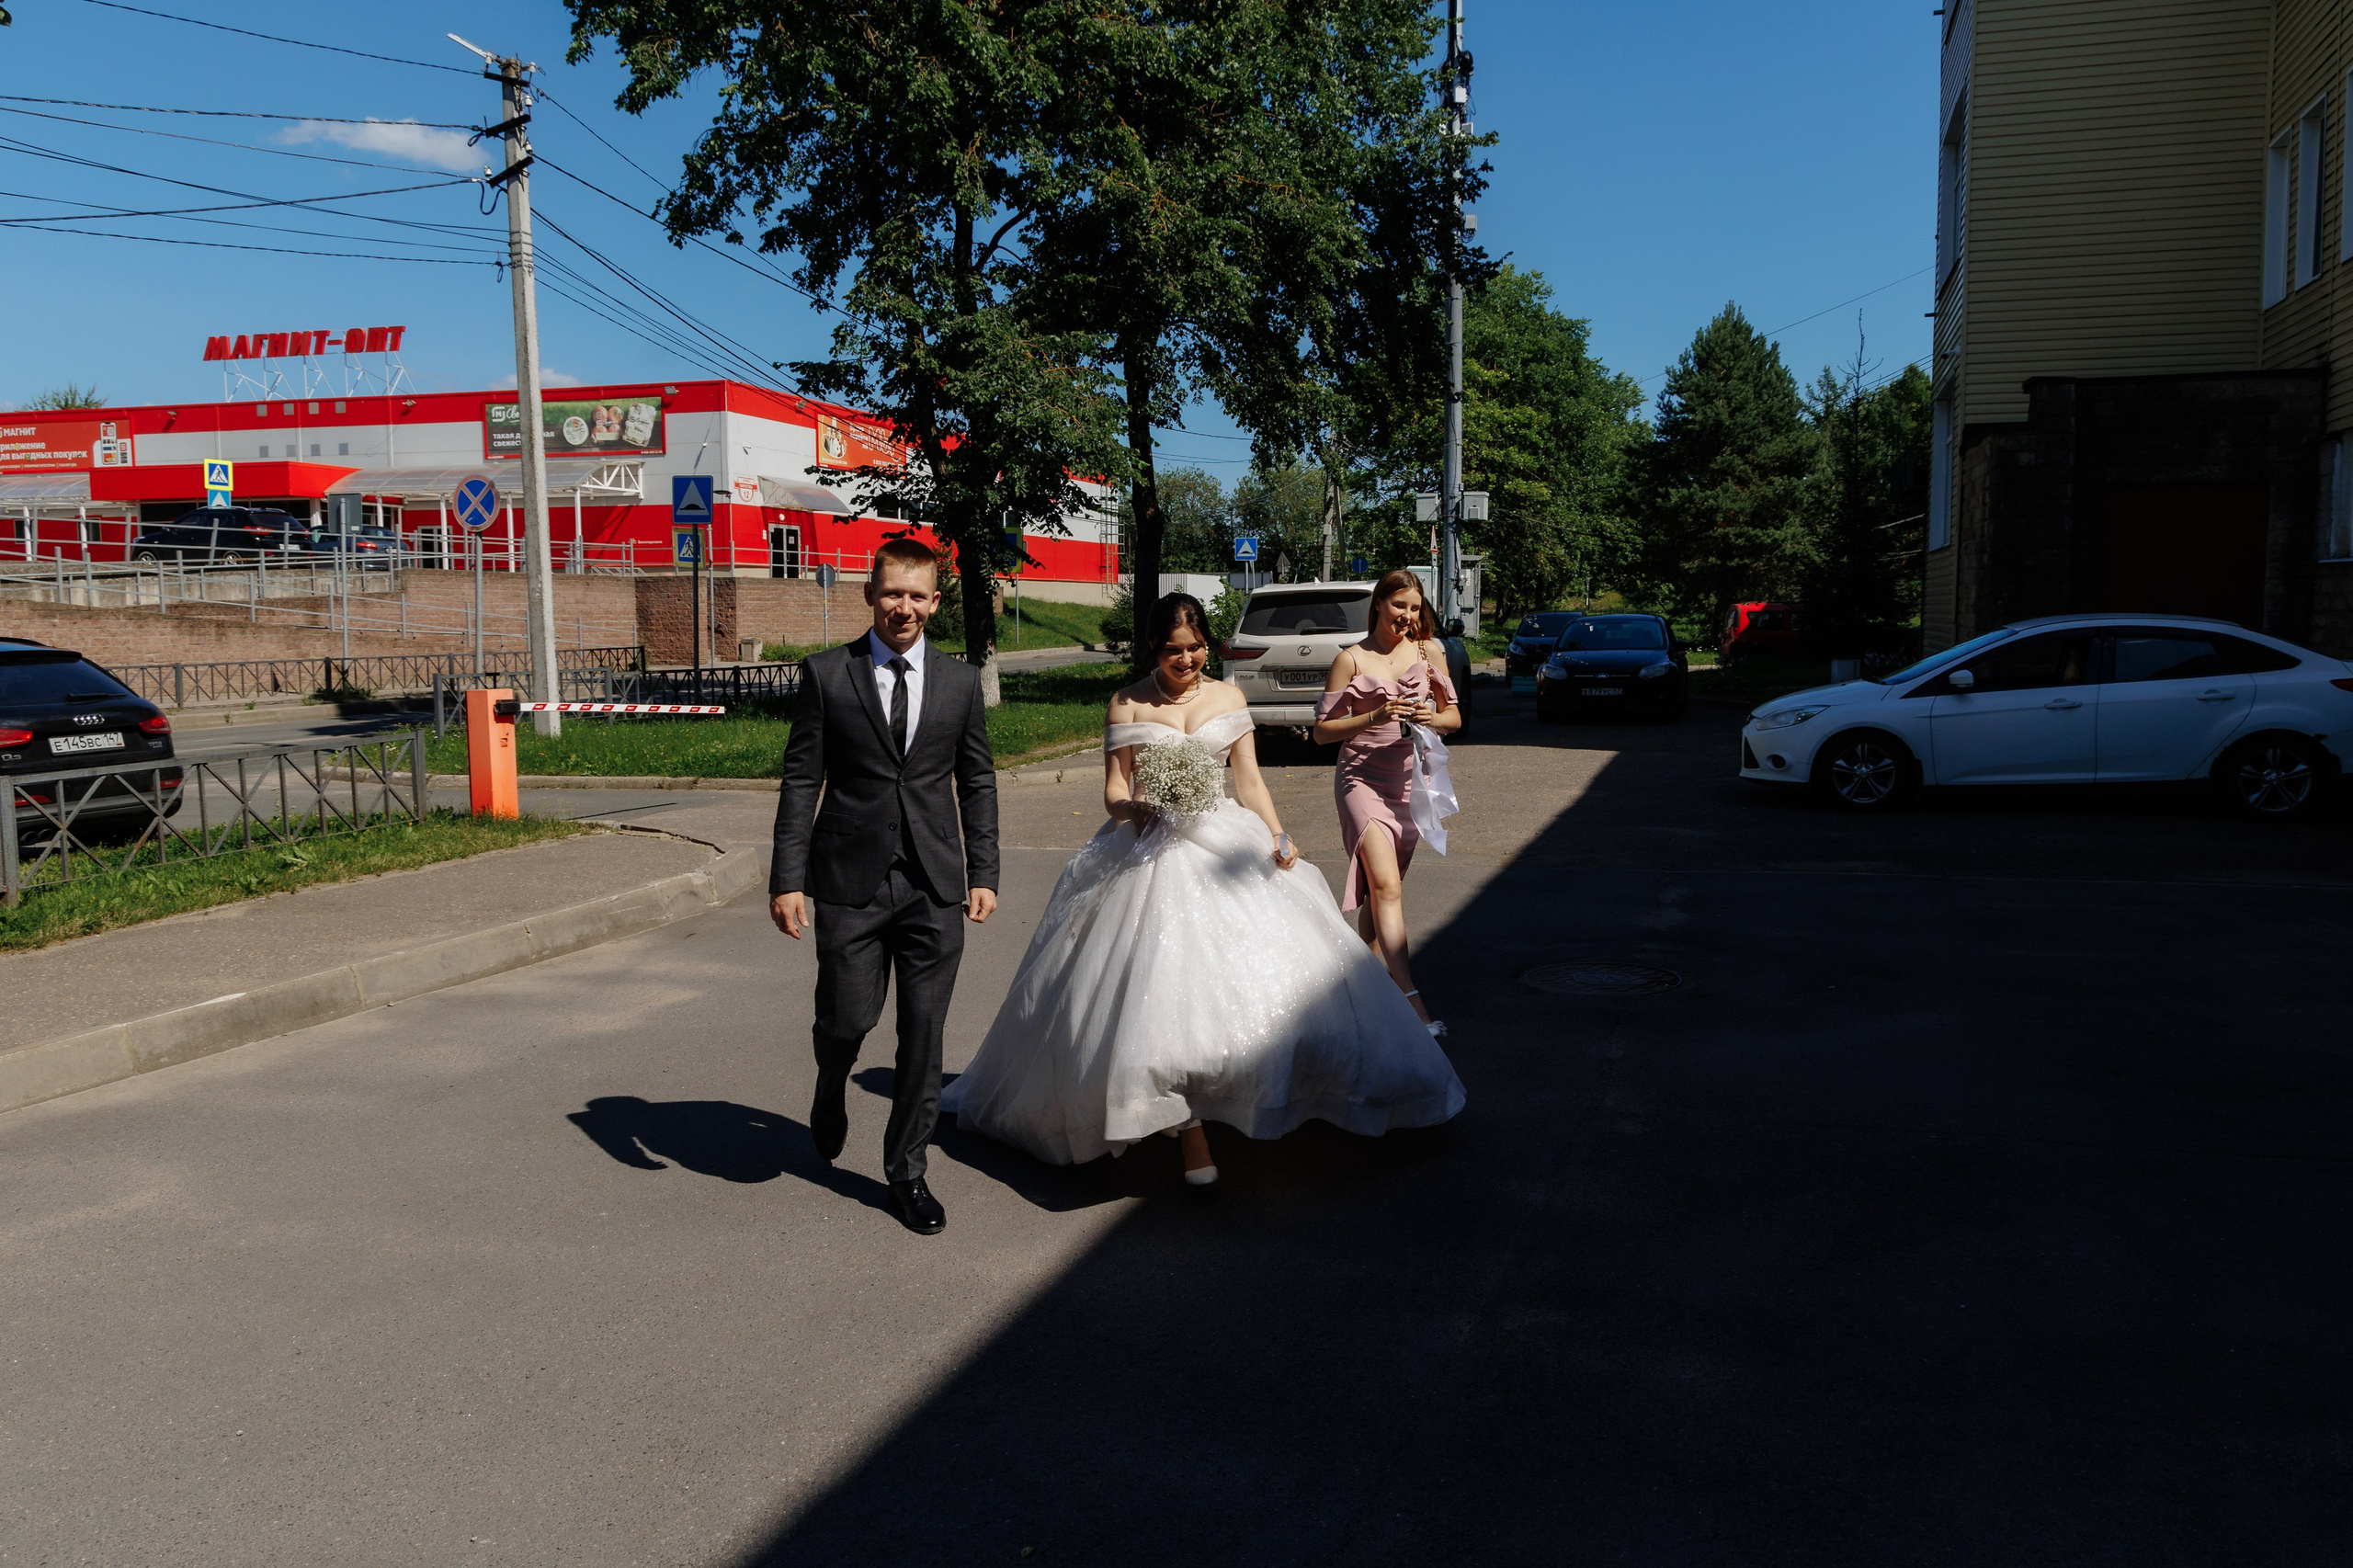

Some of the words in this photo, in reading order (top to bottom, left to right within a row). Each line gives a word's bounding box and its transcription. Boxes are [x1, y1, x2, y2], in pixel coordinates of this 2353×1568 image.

[203, 325, 405, 361] МАГНИТ-ОПТ
[4, 427, 36, 437] МАГНИТ
[0, 442, 46, 452] риложение
[744, 491, 749, 499] 12
[54, 736, 102, 752] Е145ВС
